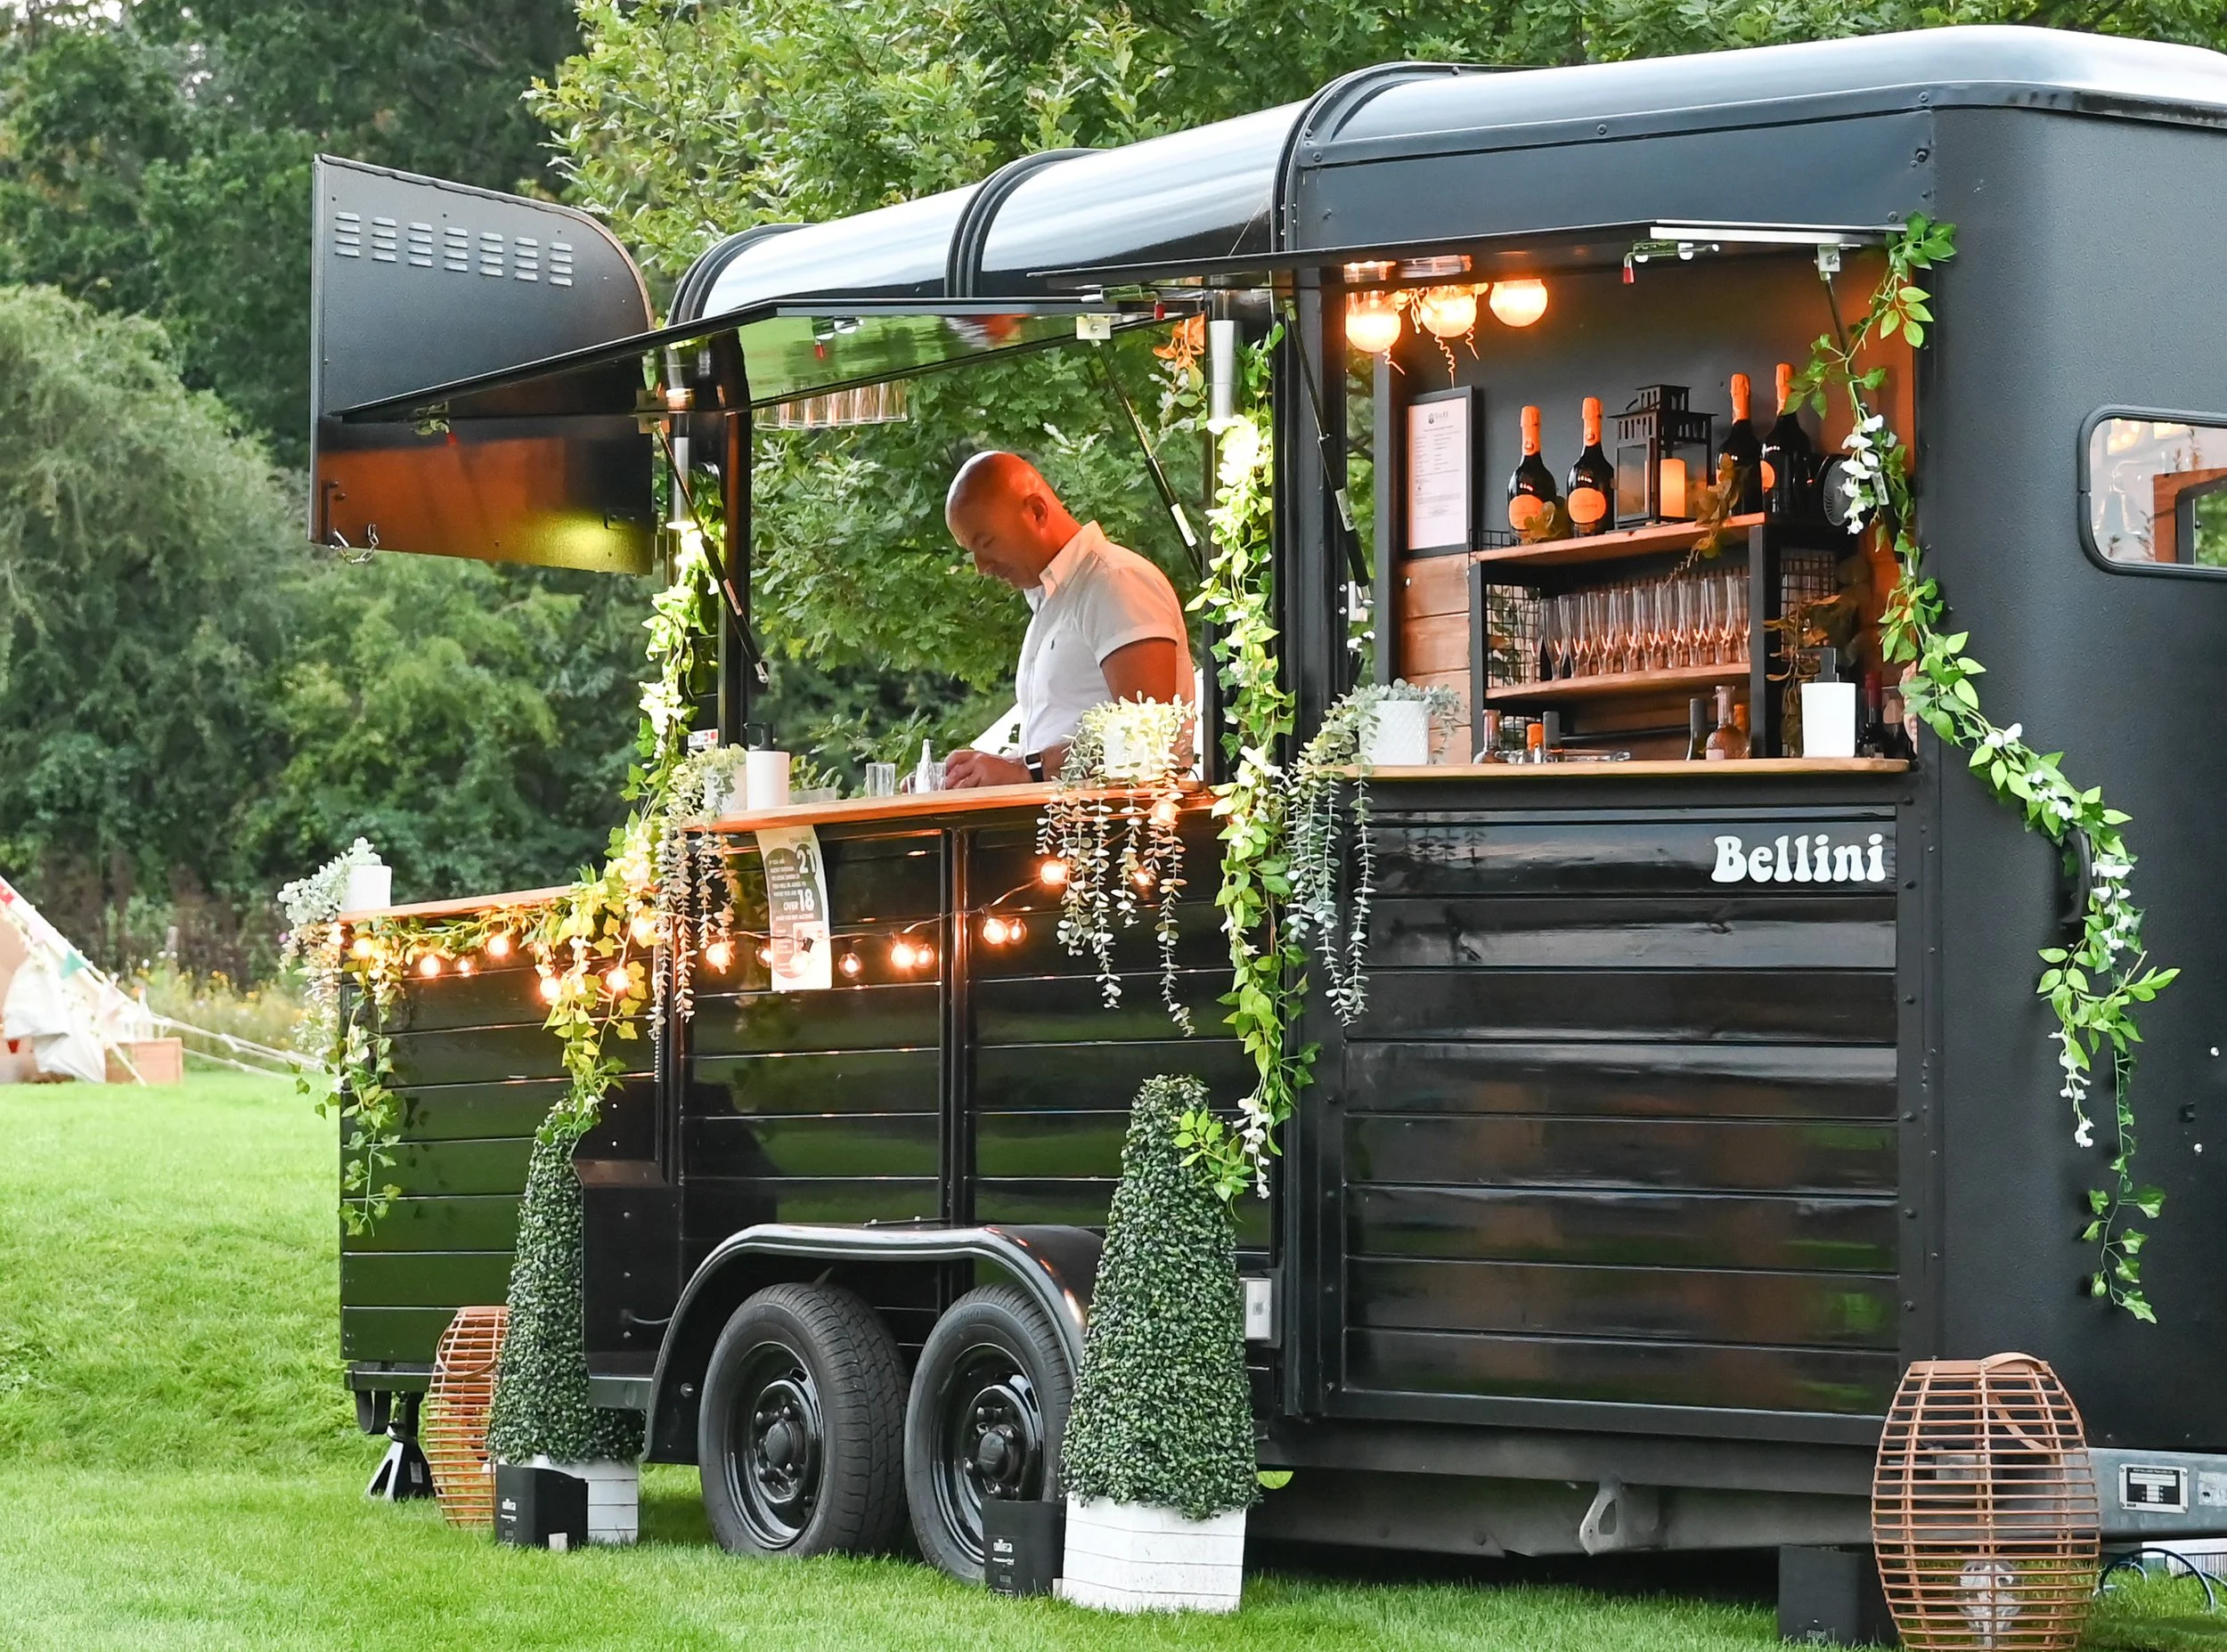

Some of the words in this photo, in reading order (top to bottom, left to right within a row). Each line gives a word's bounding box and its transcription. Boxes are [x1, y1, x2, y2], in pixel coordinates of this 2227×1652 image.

[796, 848, 816, 874] 21
[1710, 833, 1886, 883] Bellini
[783, 900, 799, 911] OVER
[798, 888, 815, 912] 18
